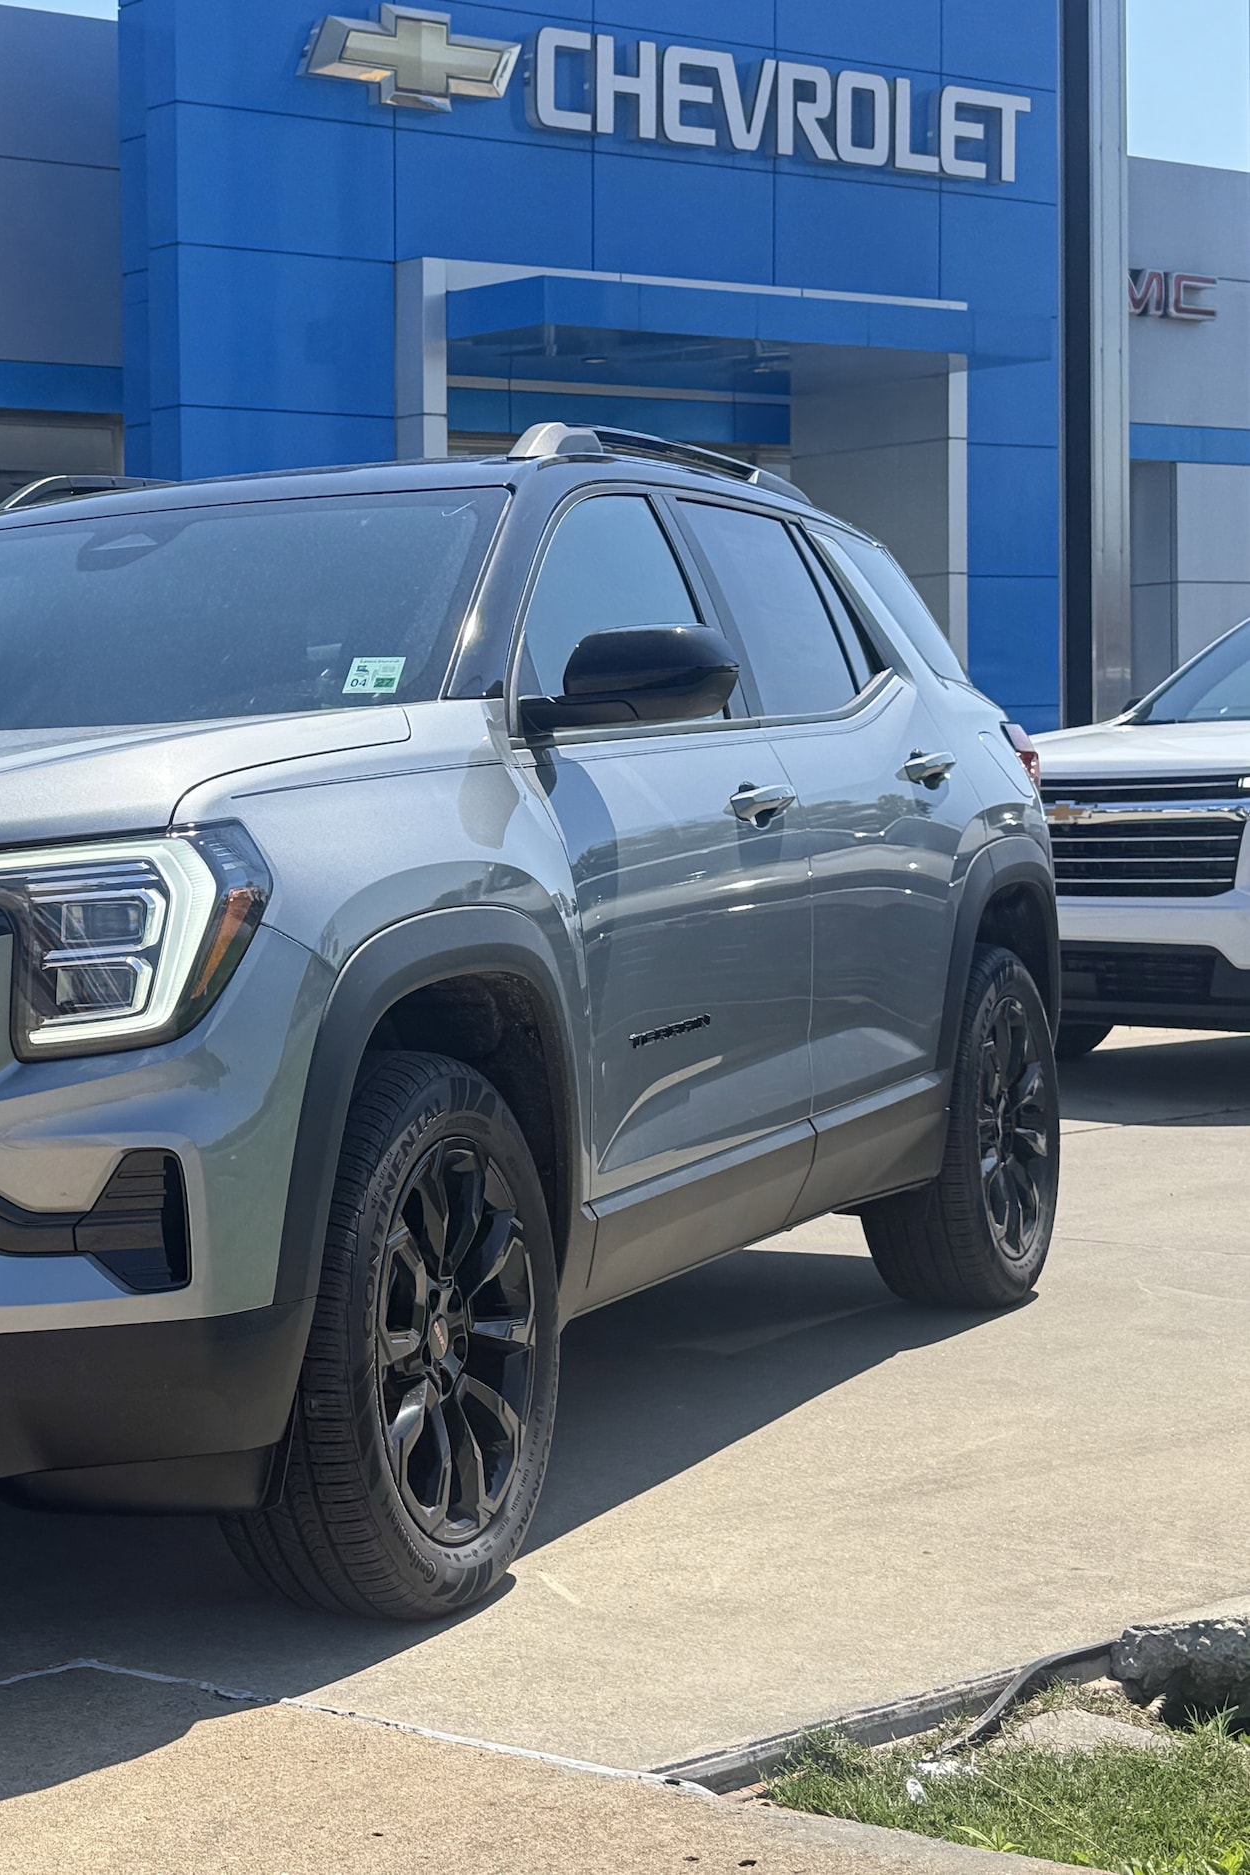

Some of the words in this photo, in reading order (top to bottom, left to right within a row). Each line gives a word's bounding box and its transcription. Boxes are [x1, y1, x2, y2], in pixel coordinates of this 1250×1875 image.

[532, 26, 1031, 184] CHEVROLET
[1128, 268, 1217, 321] MC
[350, 678, 367, 687] 04
[375, 678, 393, 687] 27
